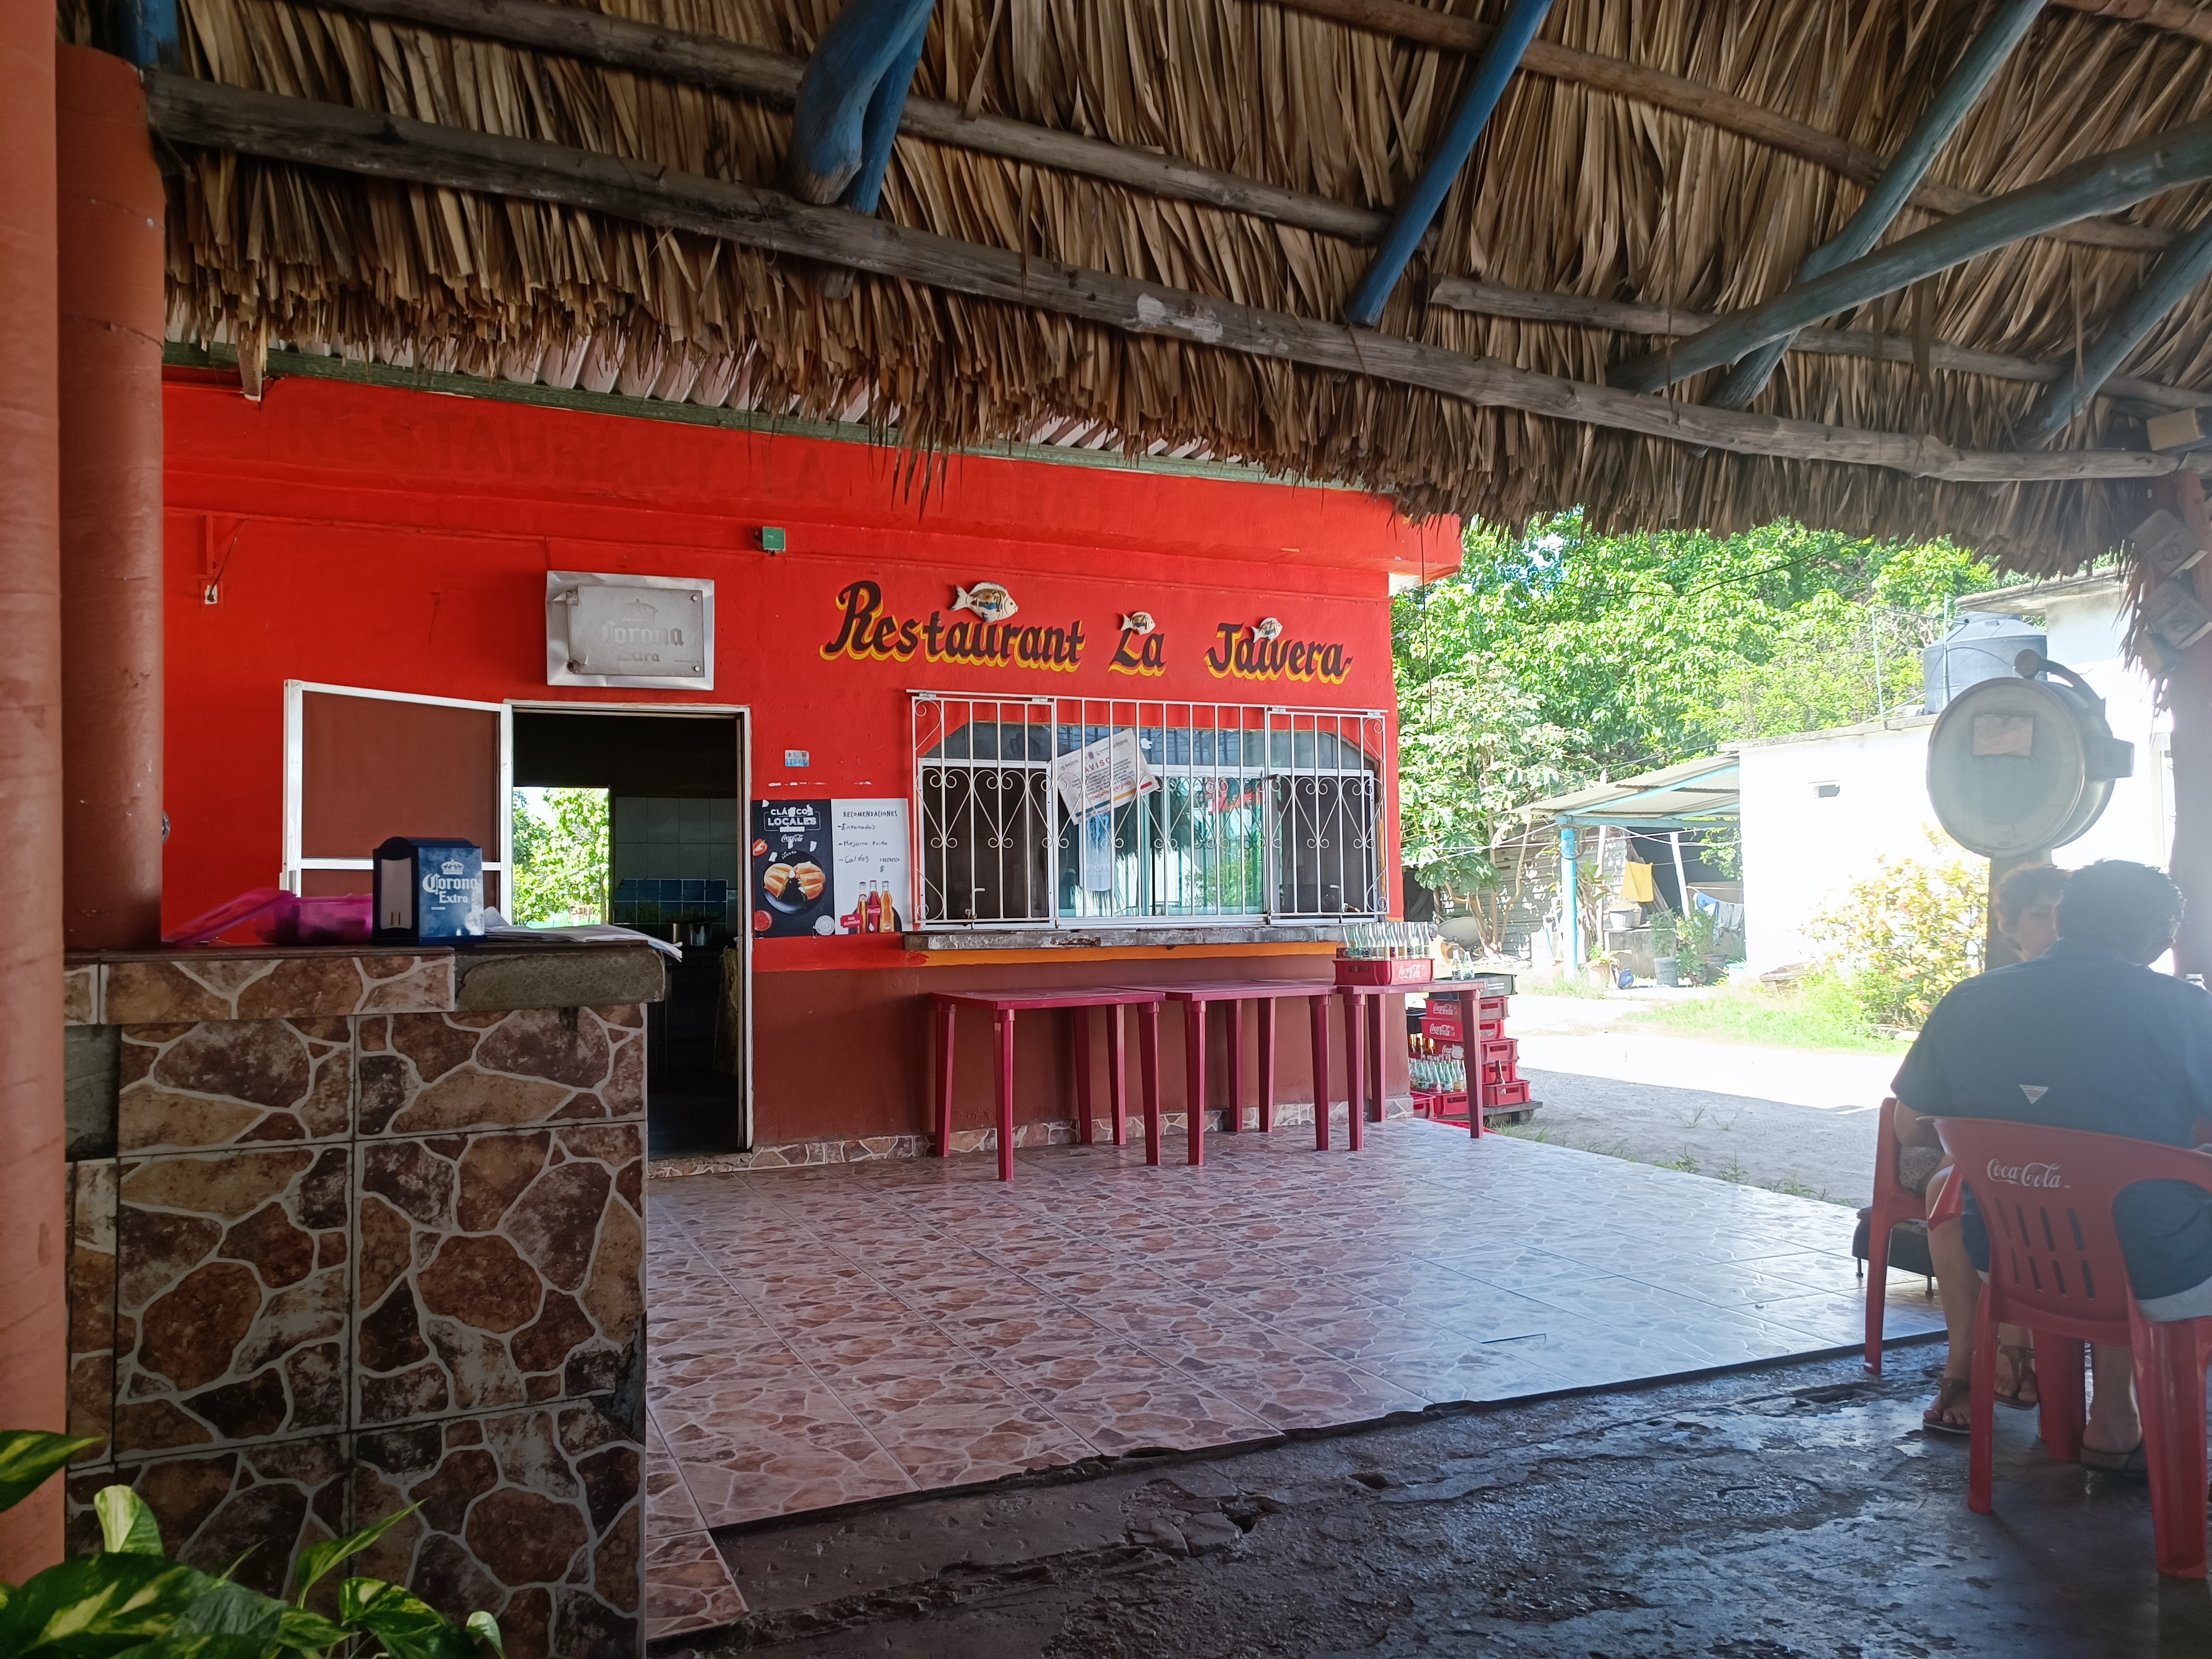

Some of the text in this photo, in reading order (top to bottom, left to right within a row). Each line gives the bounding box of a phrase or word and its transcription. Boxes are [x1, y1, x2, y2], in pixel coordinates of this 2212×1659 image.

[594, 620, 685, 648] Corona
[820, 580, 1086, 672] Restaurant
[1108, 628, 1166, 677] La
[617, 647, 660, 662] Extra
[1065, 759, 1078, 768] SALUD
[1090, 790, 1109, 801] FOMENTO
[843, 810, 898, 818] RECOMENDACIONES
[768, 817, 817, 826] LOCALES
[422, 873, 478, 895] Corona
[439, 891, 469, 904] Extra
[1986, 1159, 2062, 1188] Coca-Cola
